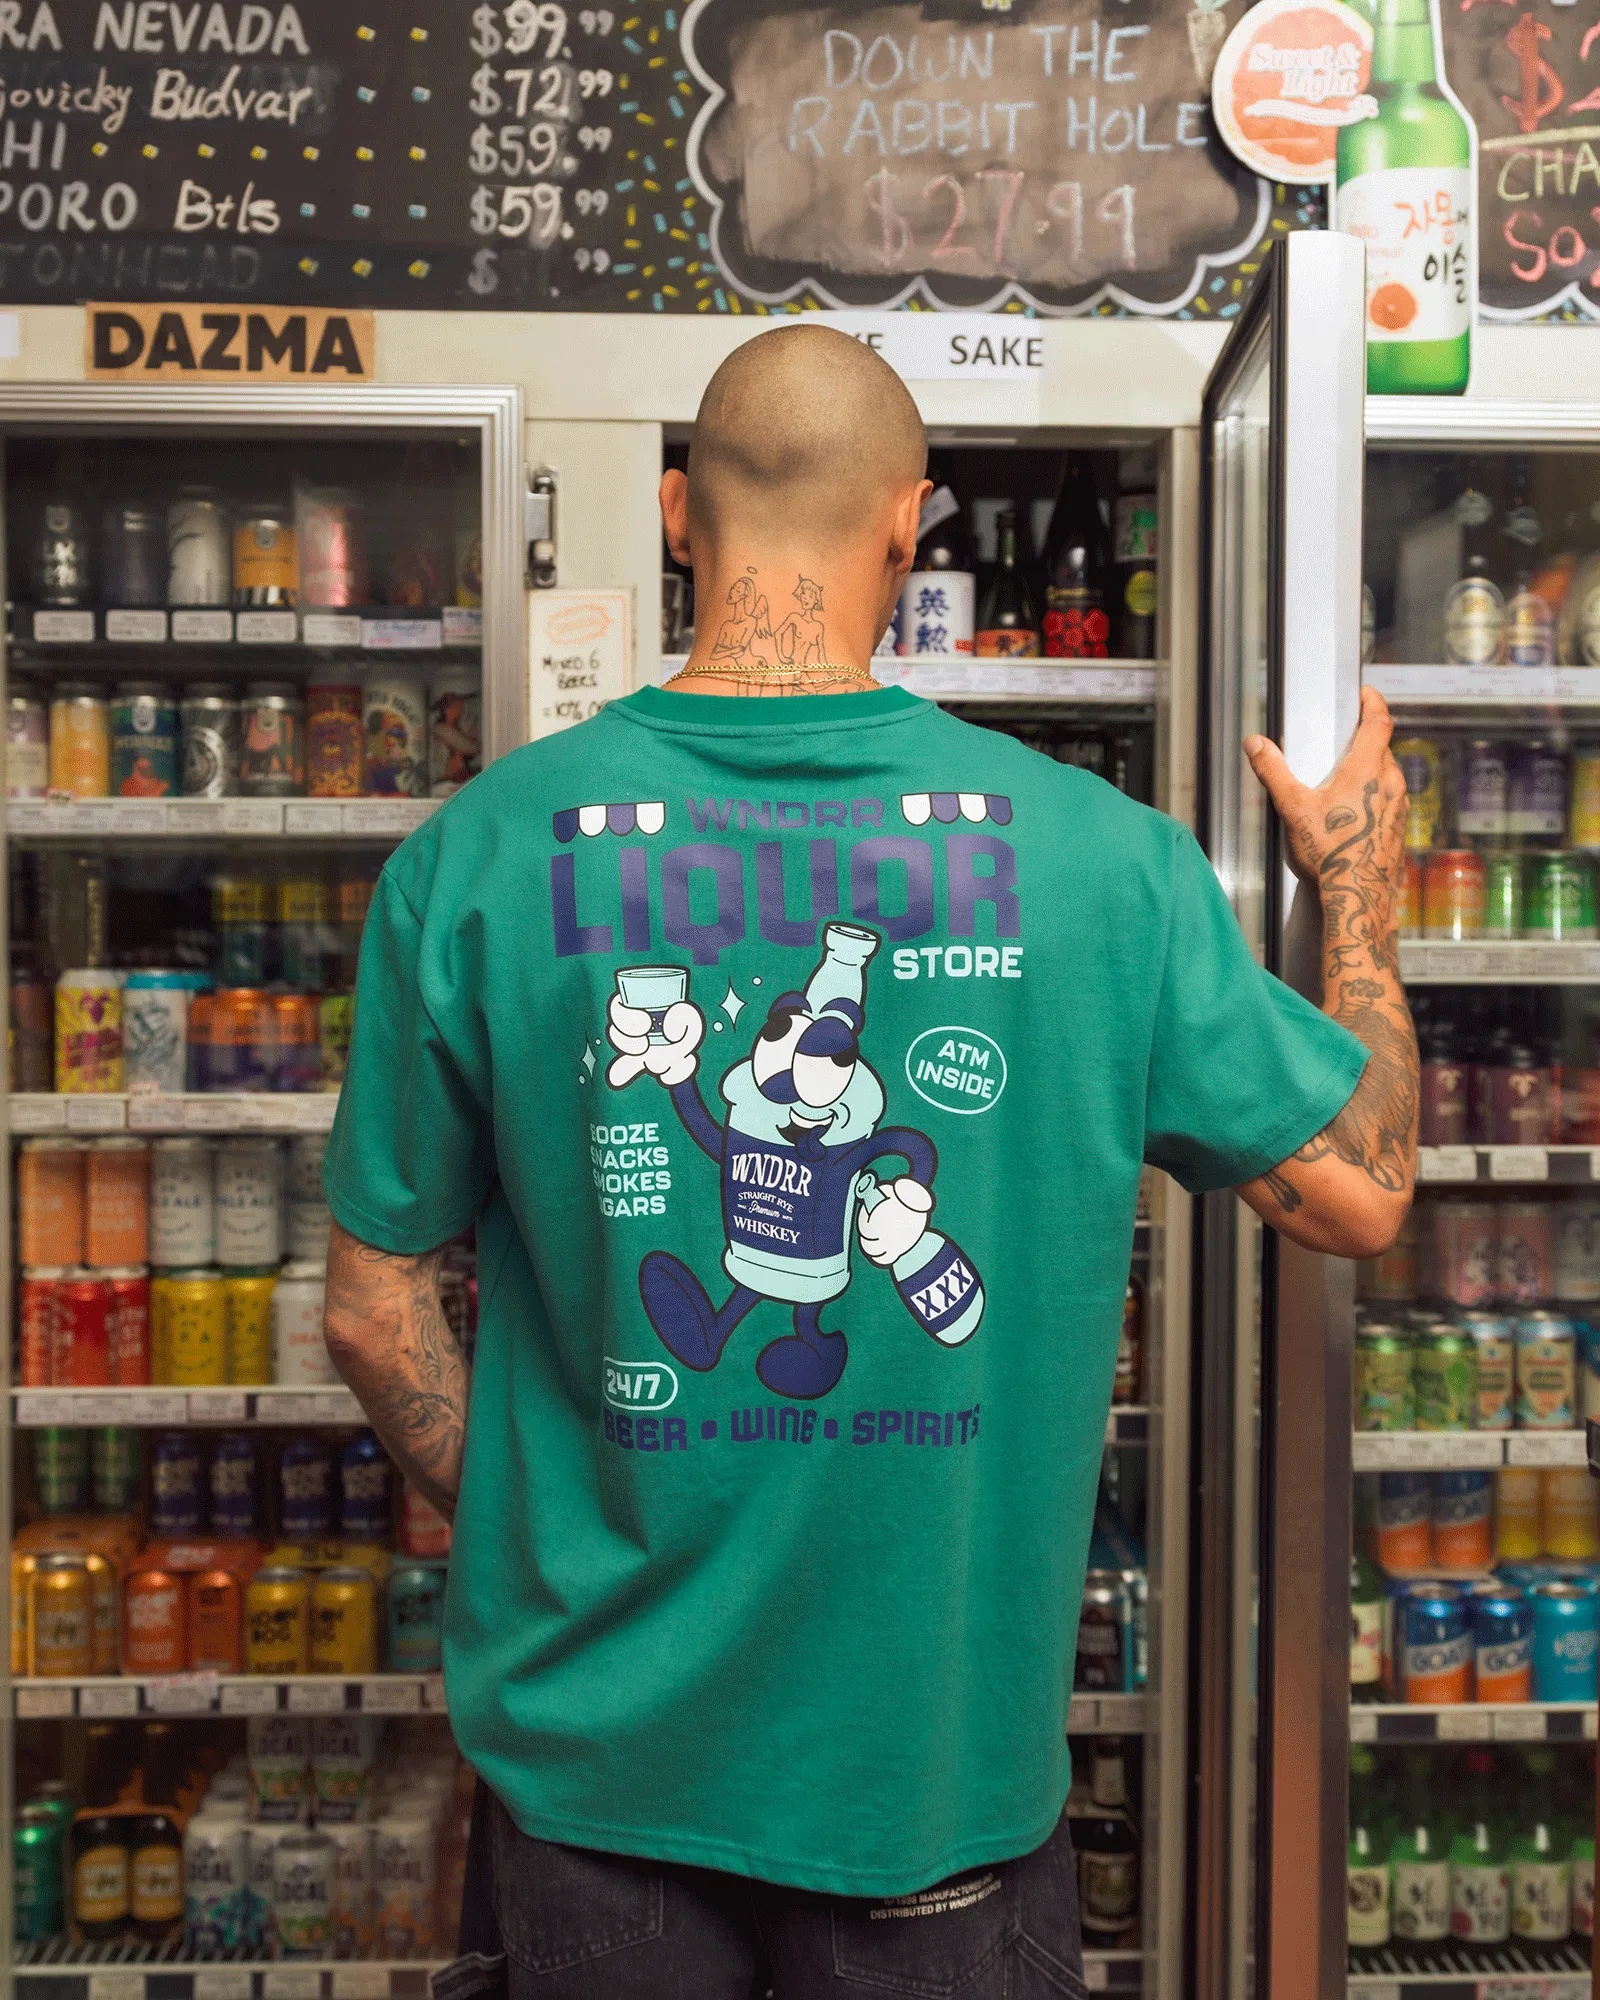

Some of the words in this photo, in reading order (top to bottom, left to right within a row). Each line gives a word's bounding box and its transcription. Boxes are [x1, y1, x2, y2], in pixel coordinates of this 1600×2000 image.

[94, 2, 310, 55] NEVADA
[822, 29, 994, 90] DOWN
[1029, 20, 1150, 82] THE
[151, 65, 313, 124] Budvar
[788, 96, 1034, 156] RABBIT
[1066, 97, 1208, 153] HOLE
[93, 311, 365, 376] DAZMA
[950, 335, 1044, 367] SAKE
[686, 797, 885, 832] WNDRR
[550, 834, 1022, 967] LIQUOR
[893, 945, 1024, 980] STORE
[937, 1039, 991, 1071] ATM
[916, 1059, 996, 1100] INSIDE
[732, 1153, 812, 1197] WNDRR
[738, 1191, 777, 1204] STRAIGHT
[777, 1198, 795, 1213] RYE
[733, 1215, 801, 1244] WHISKEY
[920, 1260, 973, 1319] XXX
[606, 1369, 660, 1400] 24/7
[603, 1407, 687, 1452] BEER
[730, 1406, 818, 1445] WINE
[870, 1903, 934, 1920] DISTRIBUTED
[935, 1900, 948, 1913] BY
